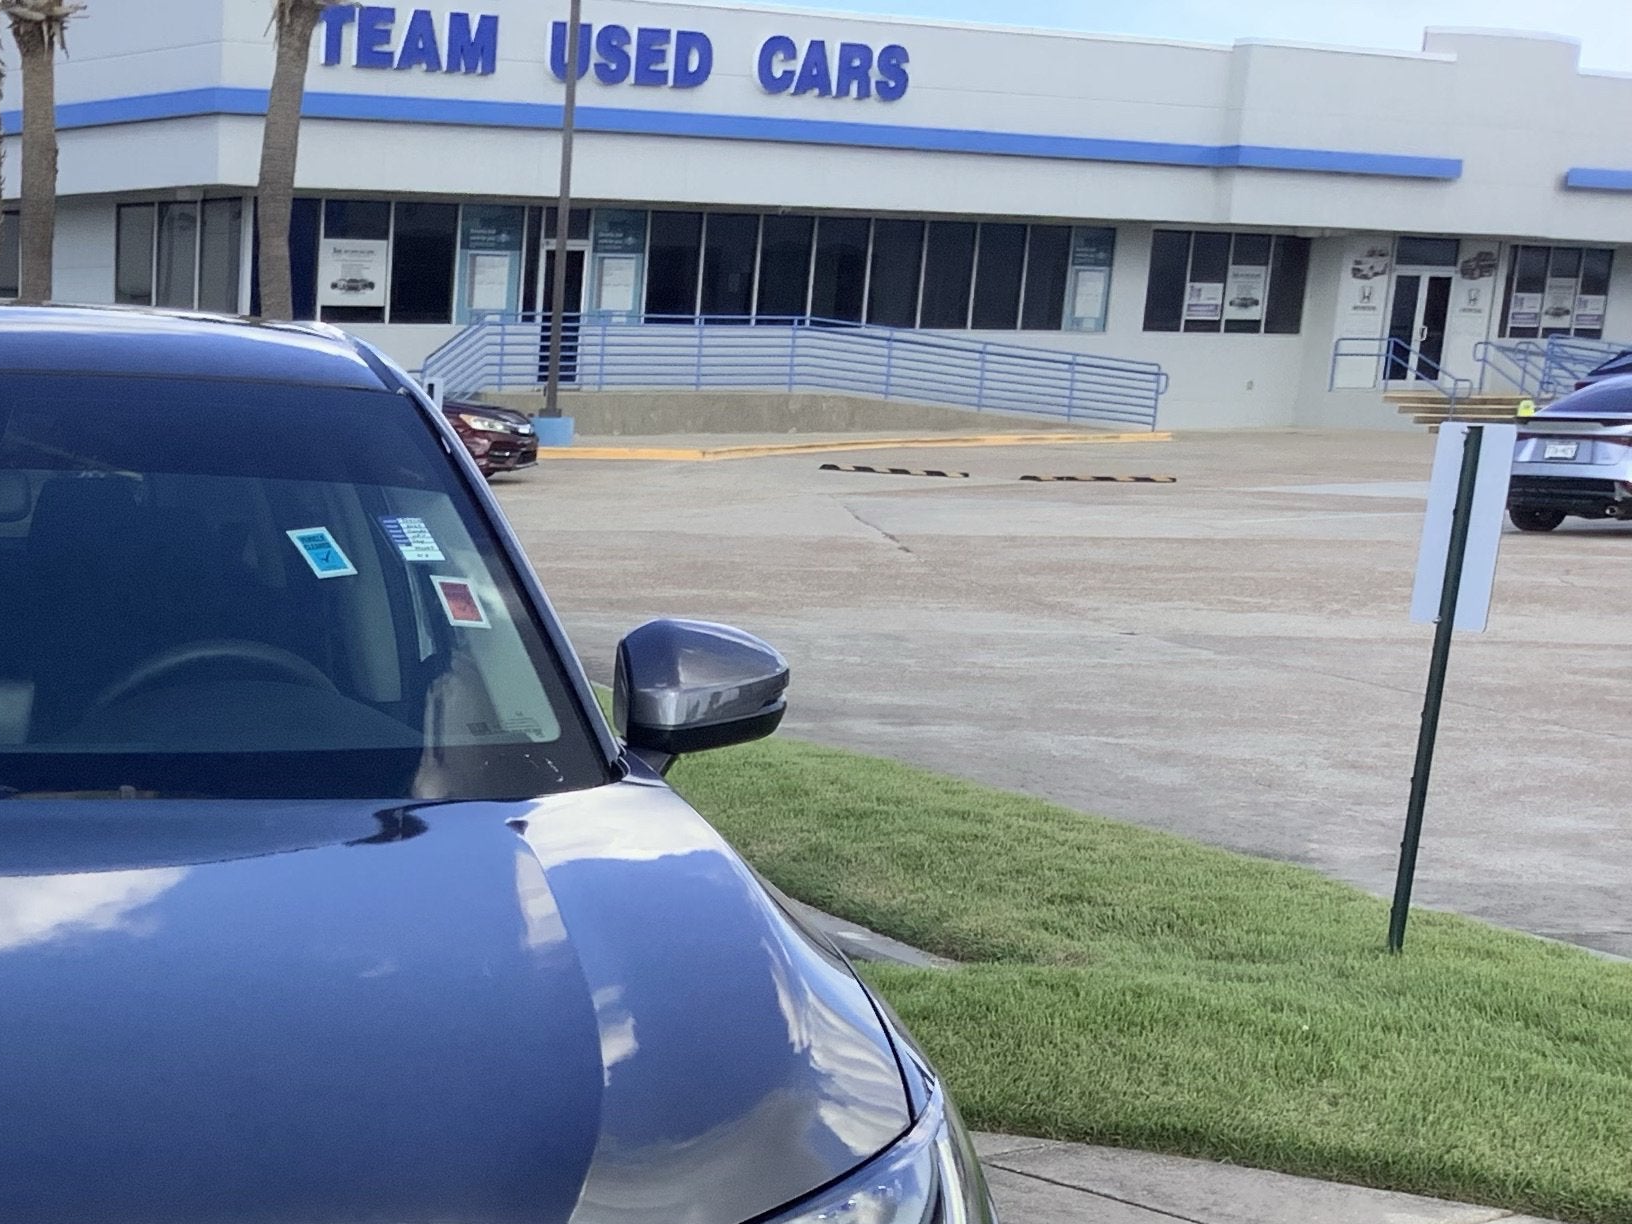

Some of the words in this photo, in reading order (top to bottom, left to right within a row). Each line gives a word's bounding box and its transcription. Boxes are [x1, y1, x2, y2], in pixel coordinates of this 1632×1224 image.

[320, 5, 499, 75] TEAM
[550, 21, 713, 89] USED
[757, 35, 910, 101] CARS
